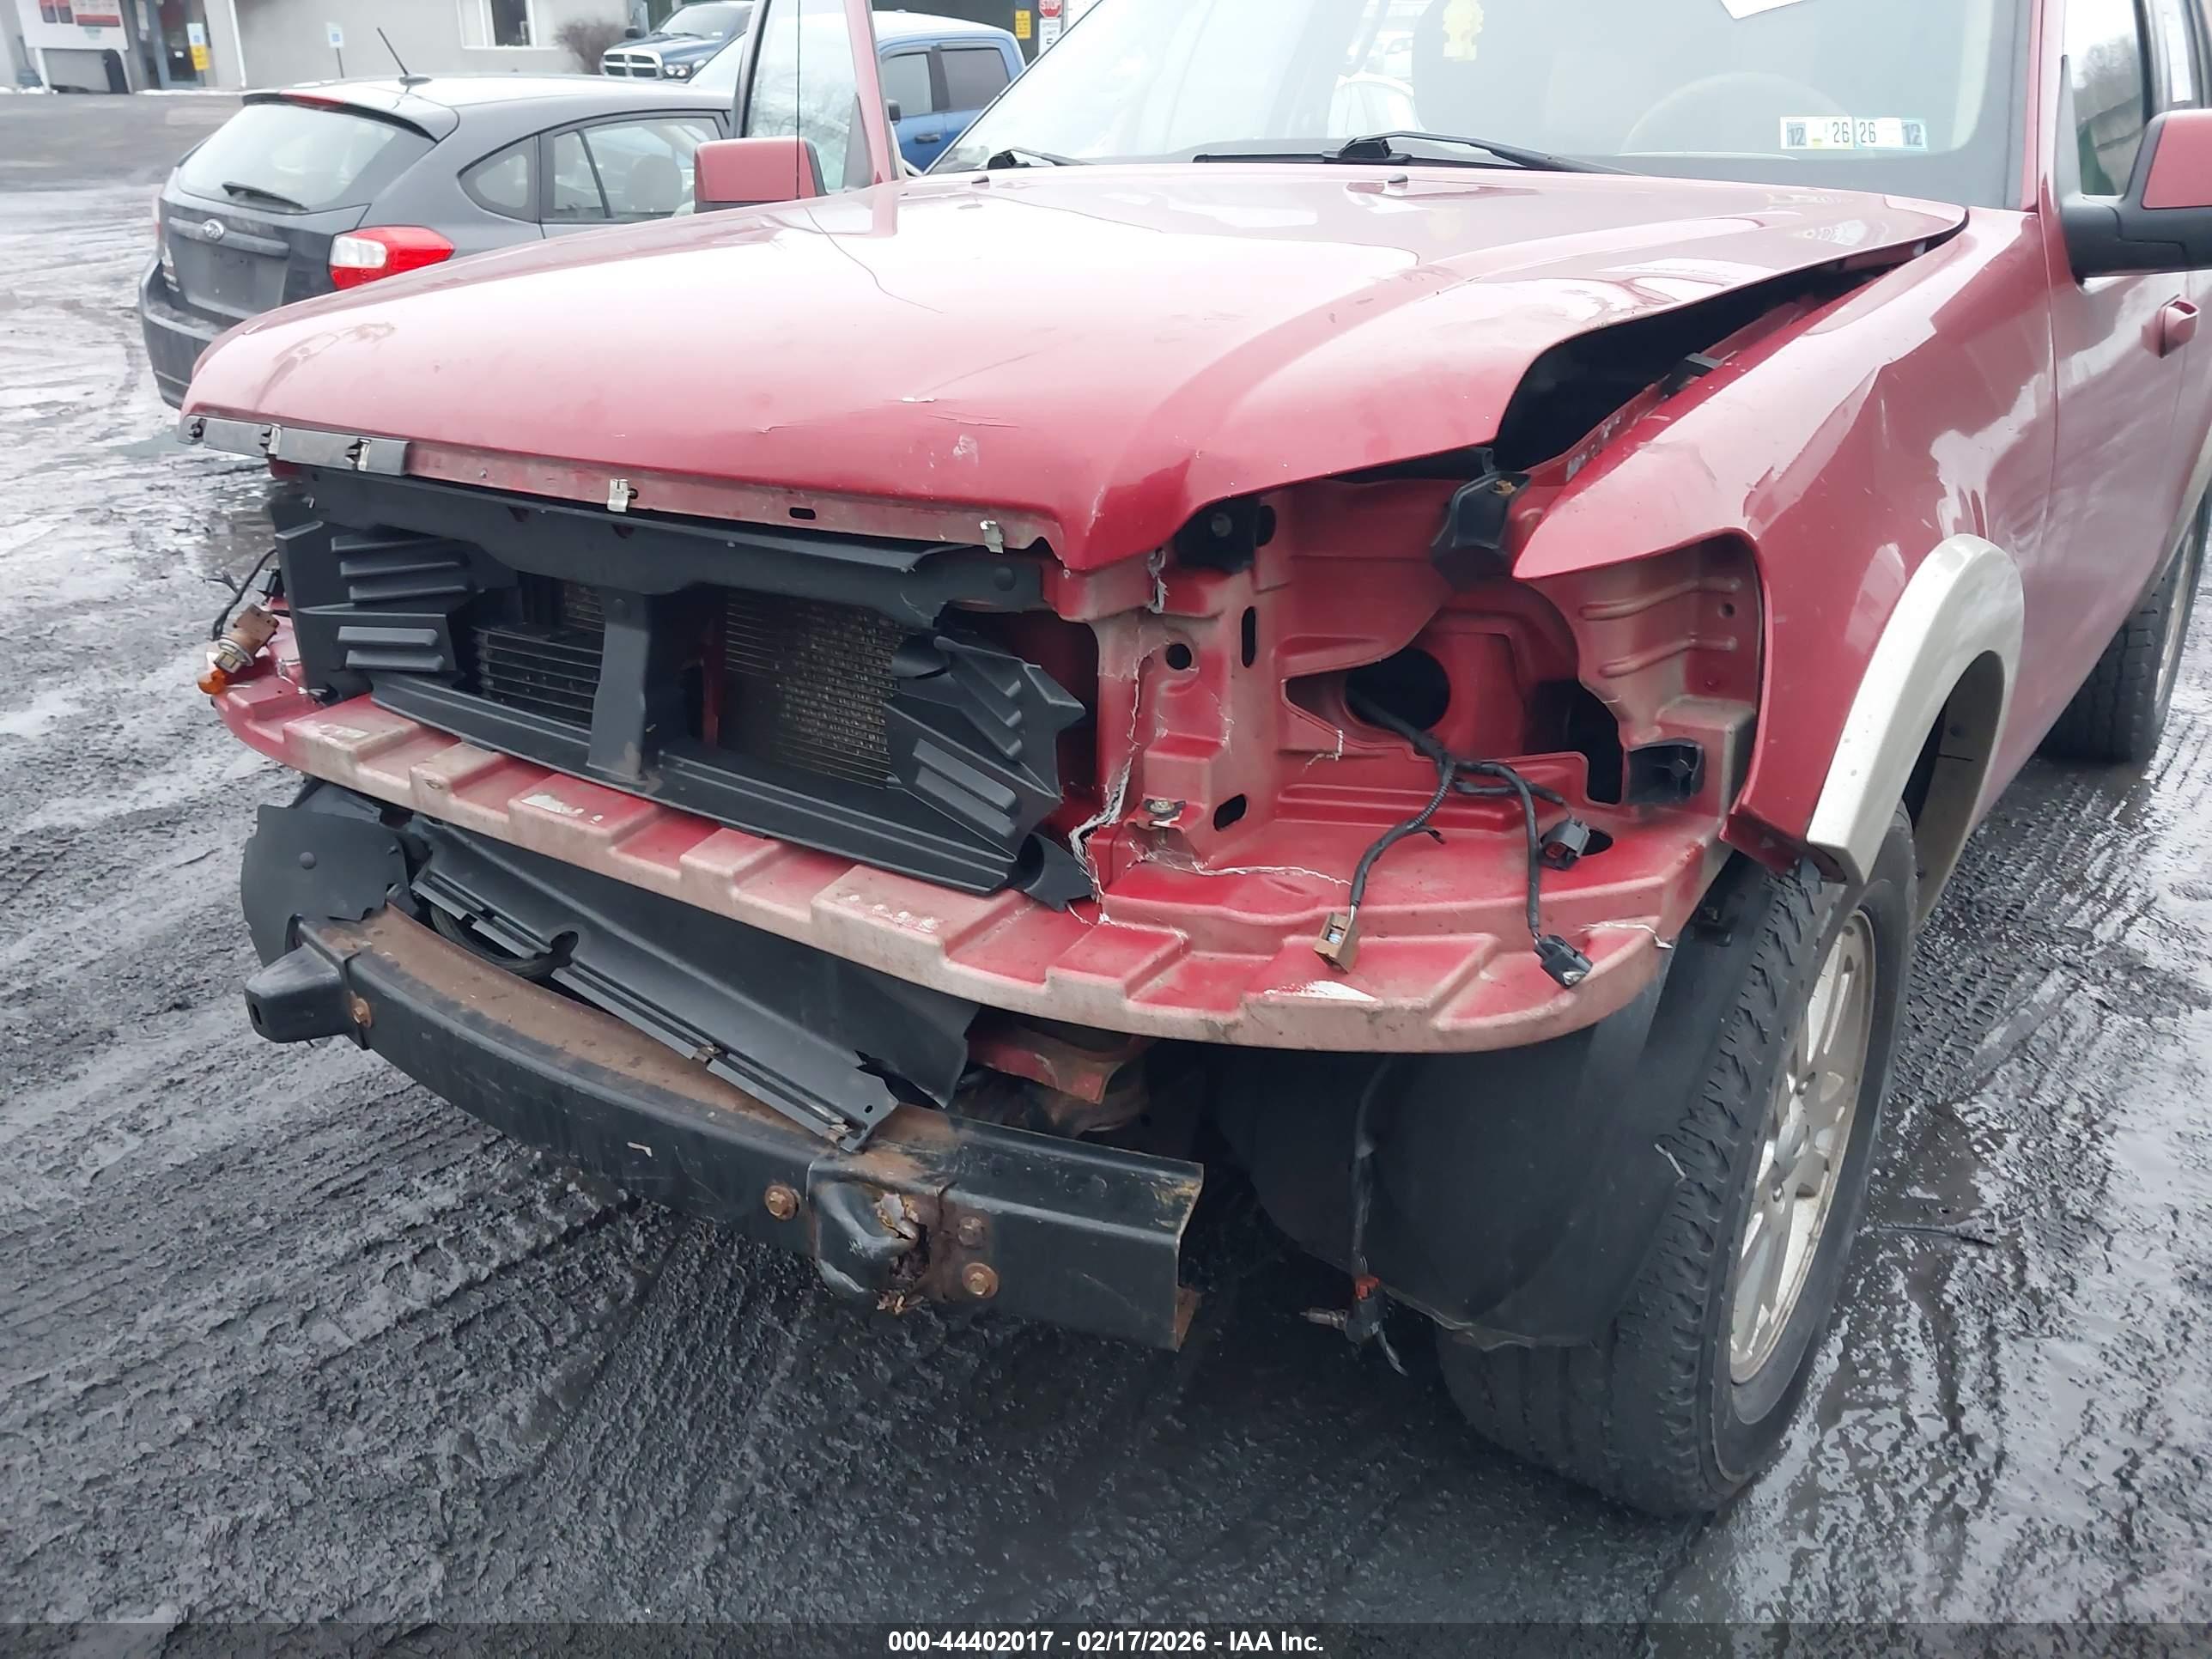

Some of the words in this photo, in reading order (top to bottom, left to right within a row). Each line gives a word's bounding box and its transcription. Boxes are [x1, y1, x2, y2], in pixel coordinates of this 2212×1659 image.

[1789, 126, 1806, 146] 12
[1832, 121, 1850, 143] 26
[1859, 121, 1876, 143] 26
[1902, 123, 1923, 146] 12
